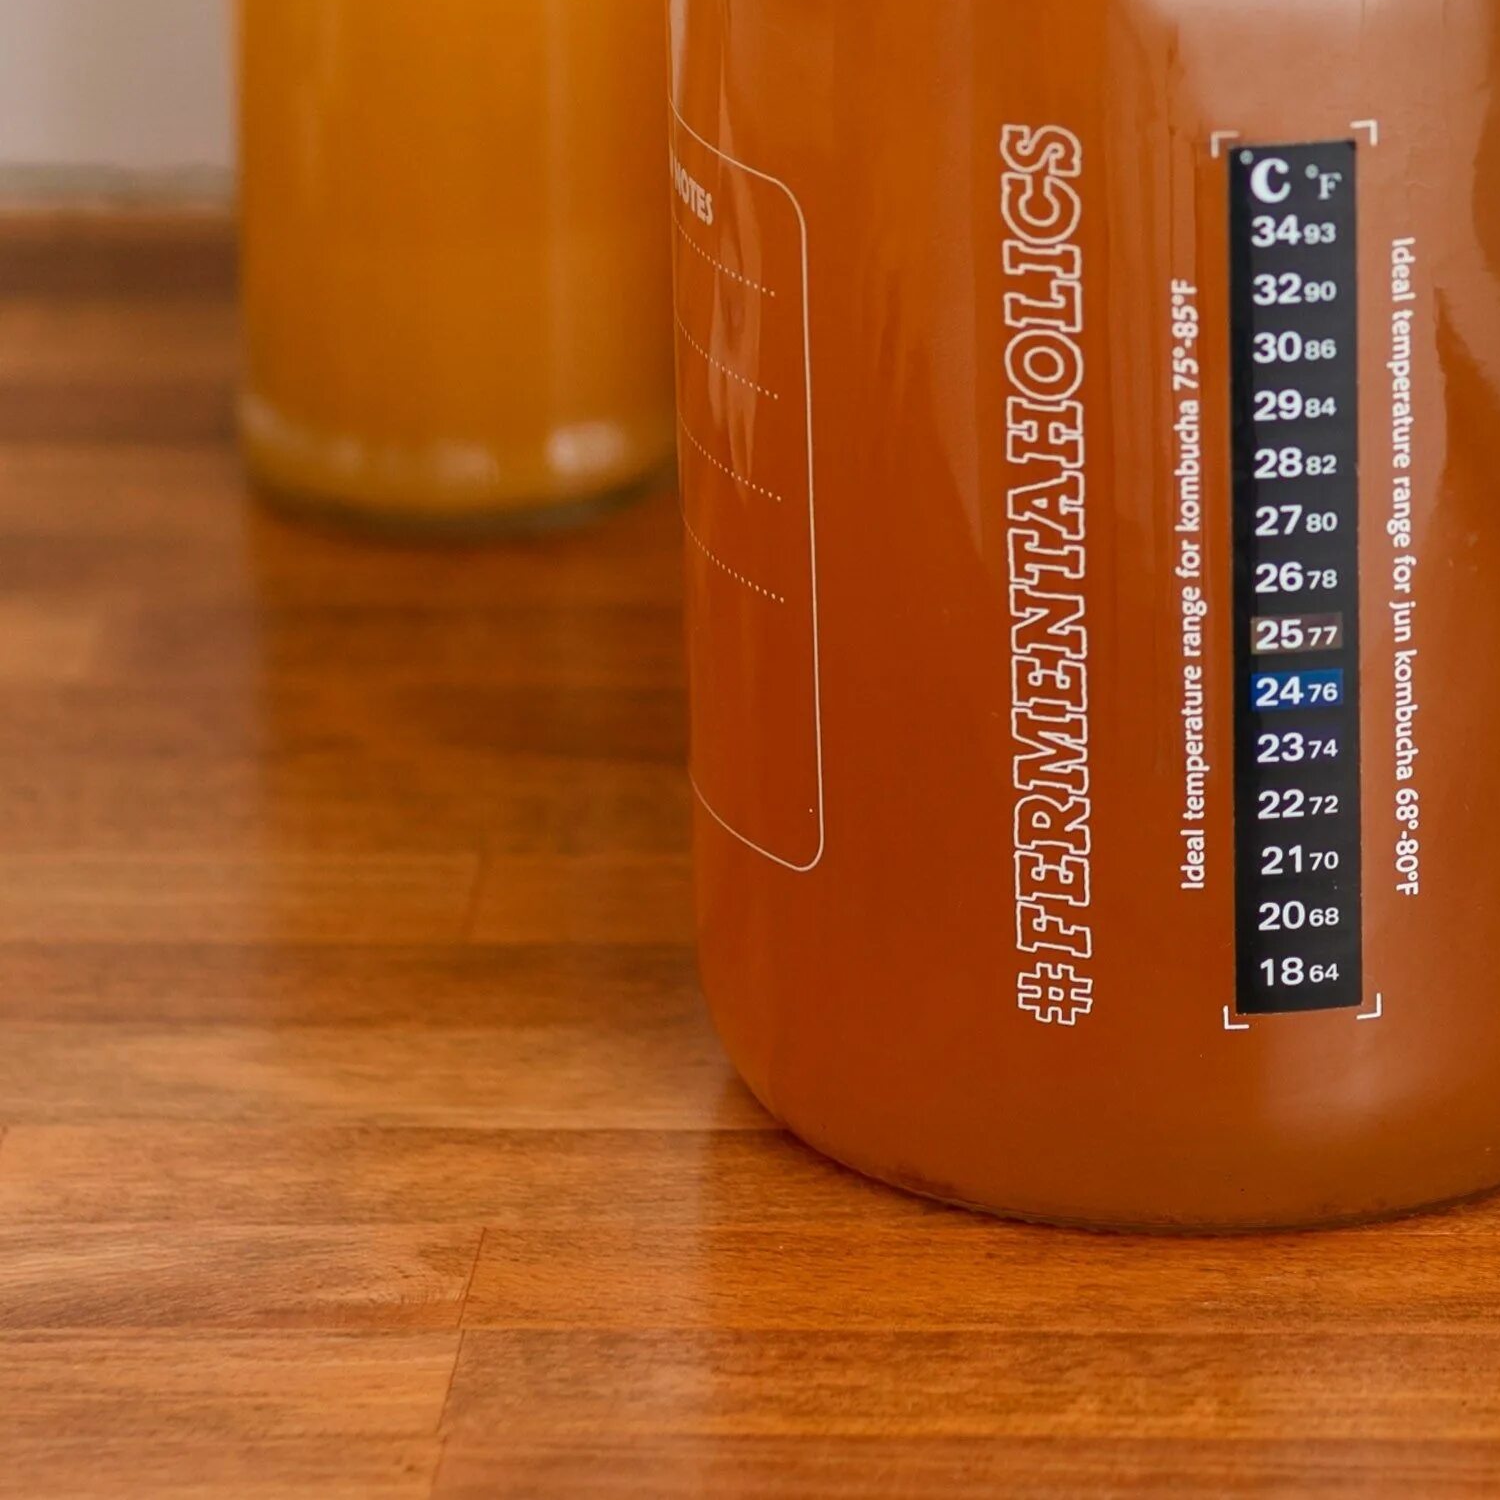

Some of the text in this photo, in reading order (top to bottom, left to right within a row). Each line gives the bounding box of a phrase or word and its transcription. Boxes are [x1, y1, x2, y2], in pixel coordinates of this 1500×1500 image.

[1251, 214, 1337, 247] 34 93
[1252, 272, 1337, 305] 32 90
[1253, 331, 1337, 363] 30 86
[1253, 389, 1337, 421] 29 84
[1254, 447, 1337, 479] 28 82
[1255, 504, 1338, 536] 27 80
[999, 123, 1095, 1027] #FERMENTAHOLICS
[1255, 561, 1338, 593] 26 78
[1385, 236, 1420, 896] Ideal temperature range for jun kombucha 68°-80°F
[1170, 277, 1211, 890] Ideal temperature range for kombucha 75°-85°F
[1256, 618, 1338, 650] 25 77
[1256, 675, 1338, 707] 24 76
[1257, 731, 1339, 763] 23 74
[1257, 788, 1339, 819] 22 72
[1261, 844, 1339, 875] 21 70
[1258, 900, 1339, 931] 20 68
[1260, 956, 1340, 986] 18 64
